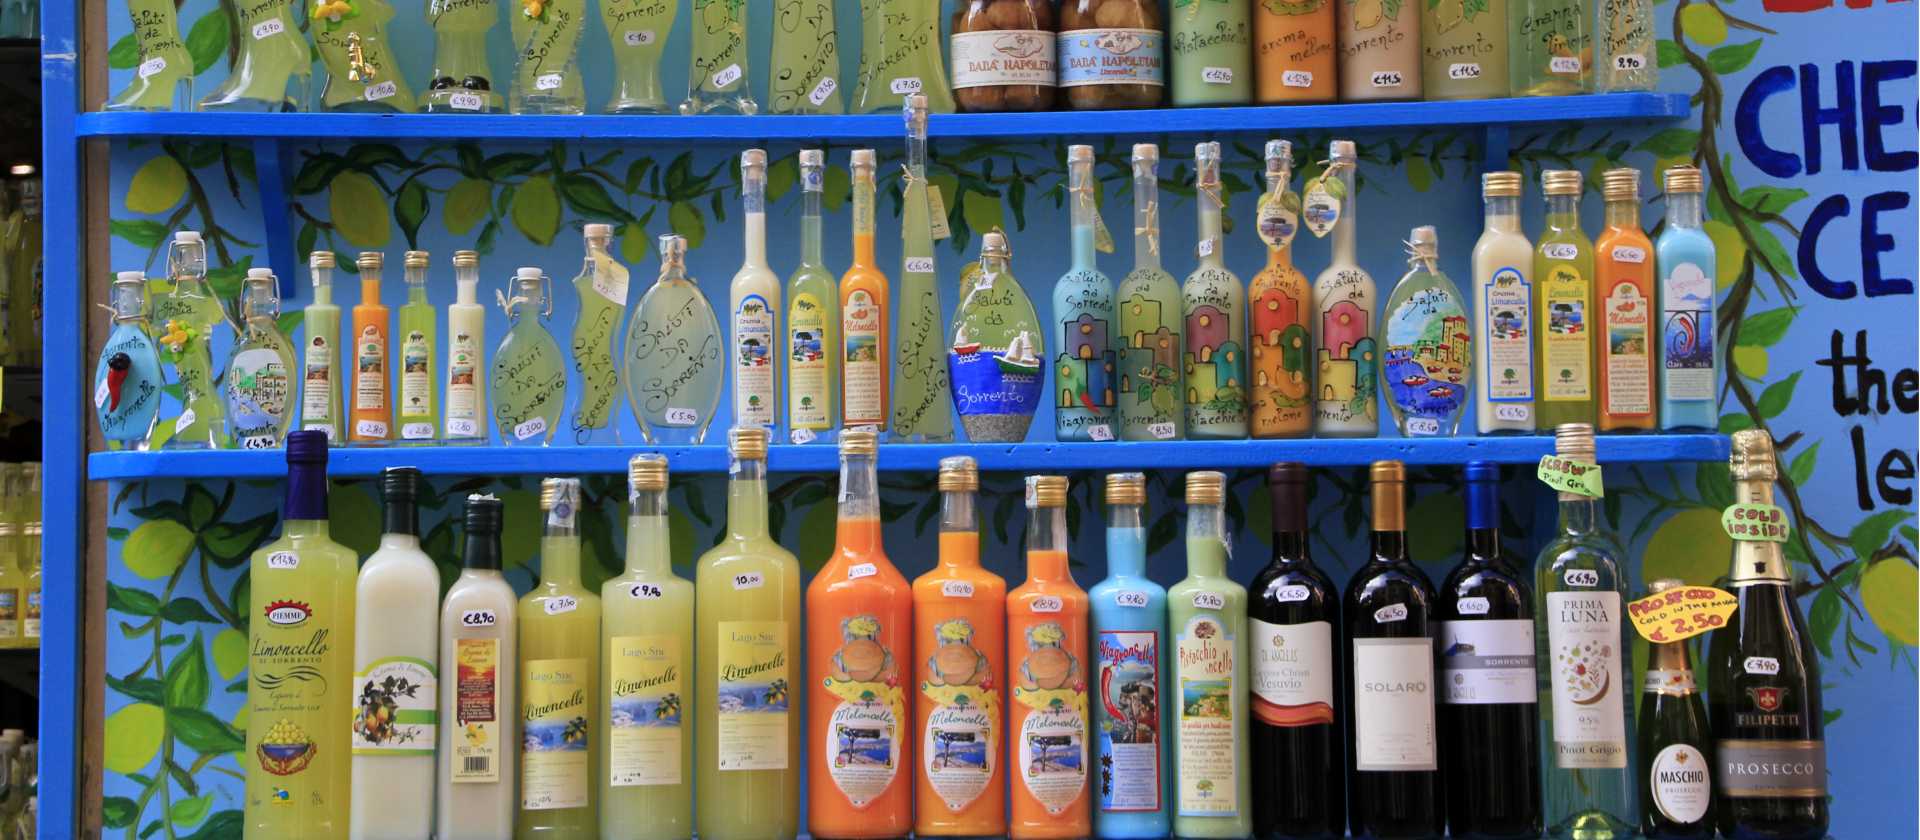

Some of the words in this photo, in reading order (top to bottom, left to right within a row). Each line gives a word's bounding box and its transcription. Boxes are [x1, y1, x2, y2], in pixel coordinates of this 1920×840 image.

[696, 32, 742, 93] Sorrento
[1735, 60, 1920, 178] CHE
[1816, 329, 1920, 416] the
[957, 386, 1024, 415] Sorrento
[1851, 425, 1920, 512] le
[1733, 508, 1781, 522] COLD
[1567, 572, 1597, 585] €6,90
[1563, 600, 1603, 609] PRIMA
[464, 612, 495, 625] €8,90
[1561, 611, 1609, 623] LUNA
[252, 628, 329, 657] Limoncello
[721, 652, 785, 682] Limoncello
[615, 667, 677, 697] Limoncello
[1260, 677, 1302, 689] Vesuvio
[1364, 681, 1427, 693] SOLARO
[525, 690, 585, 721] Limoncello
[835, 709, 894, 724] Meloncello
[931, 713, 988, 727] Meloncello
[1025, 715, 1082, 730] Meloncello
[1737, 713, 1800, 727] FILIPETTI
[1560, 745, 1585, 754] Pinot
[1728, 762, 1815, 776] PROSECCO
[1660, 769, 1704, 785] MASCHIO
